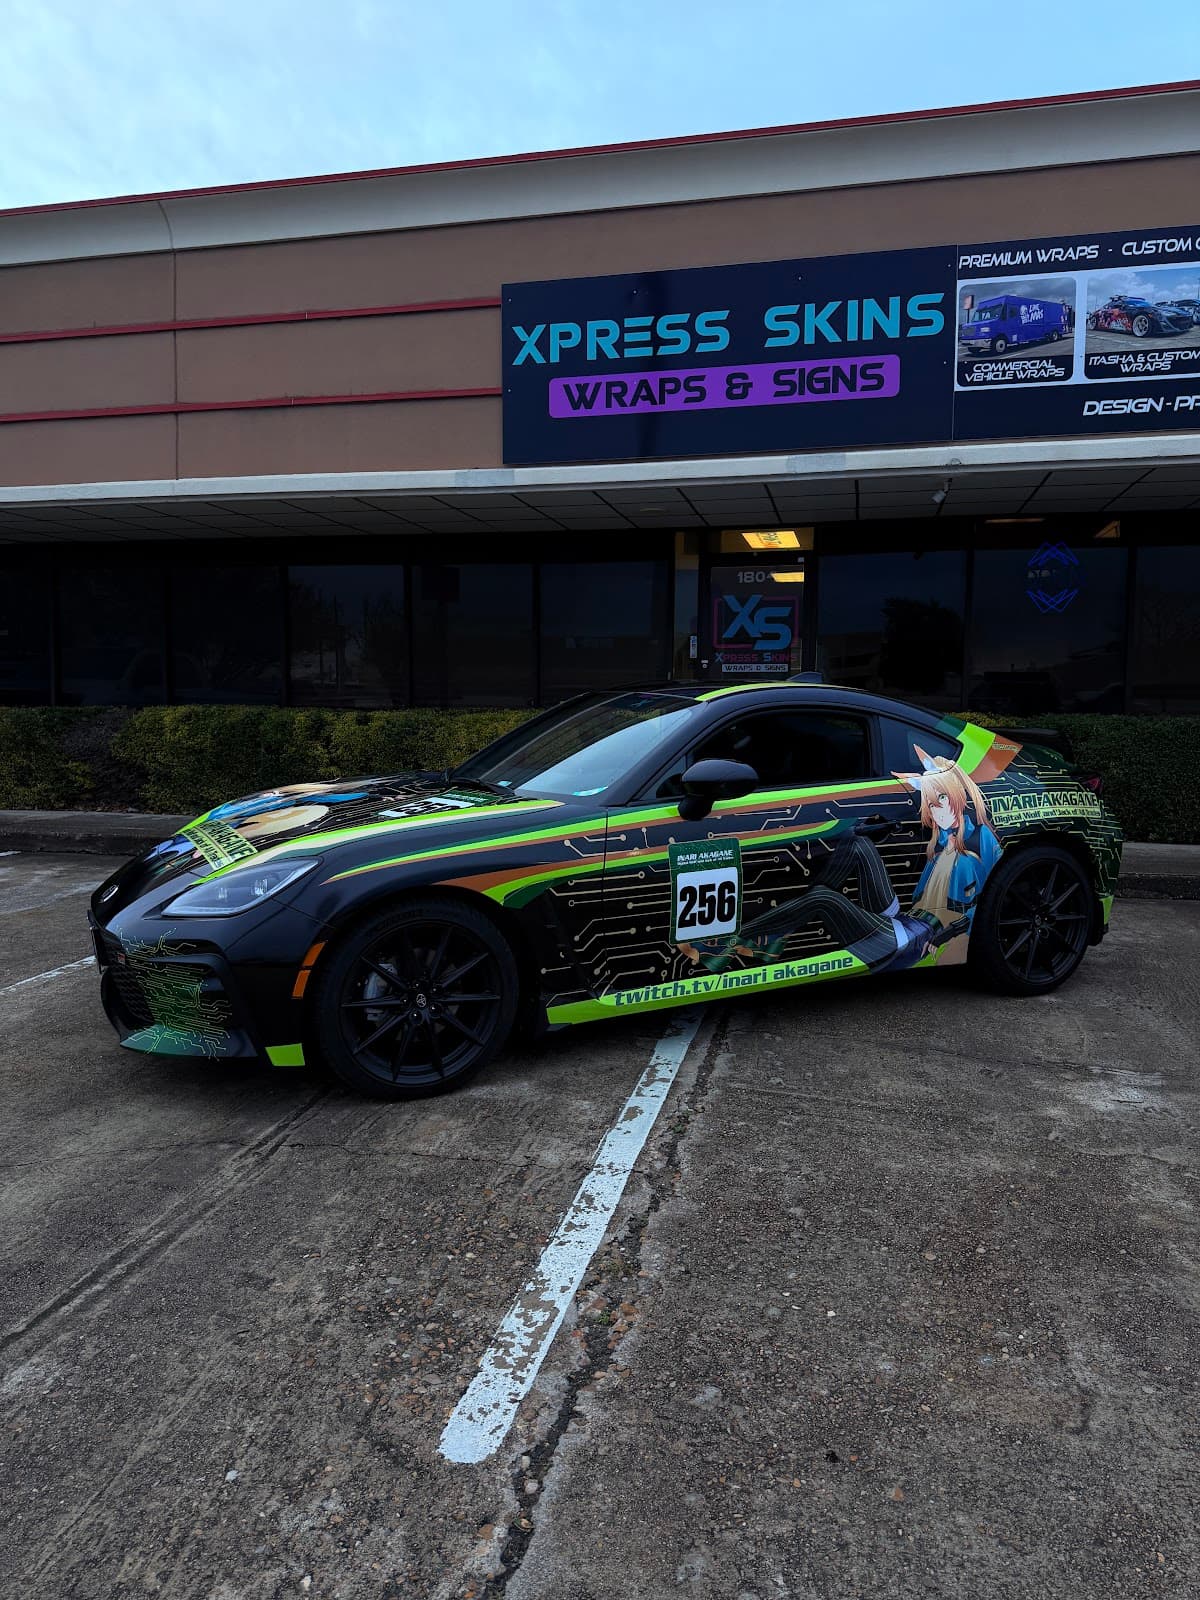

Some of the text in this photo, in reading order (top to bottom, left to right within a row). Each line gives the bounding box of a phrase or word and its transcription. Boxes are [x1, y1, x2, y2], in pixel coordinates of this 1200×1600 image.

[958, 251, 1032, 270] PREMIUM
[1036, 245, 1100, 263] WRAPS
[1121, 237, 1192, 256] CUSTOM
[511, 293, 945, 366] XPRESS SKINS
[973, 359, 1056, 372] COMMERCIAL
[1088, 350, 1200, 366] ITASHA & CUSTOM
[964, 367, 1065, 382] VEHICLE WRAPS
[1120, 361, 1171, 373] WRAPS
[562, 362, 886, 411] WRAPS & SIGNS
[1082, 397, 1164, 416] DESIGN
[737, 571, 776, 584] 180
[722, 594, 792, 651] XS
[715, 652, 757, 663] XPRESS
[992, 794, 1038, 813] INARI
[994, 813, 1021, 825] Digital
[677, 853, 698, 862] INARI
[677, 880, 736, 928] 256
